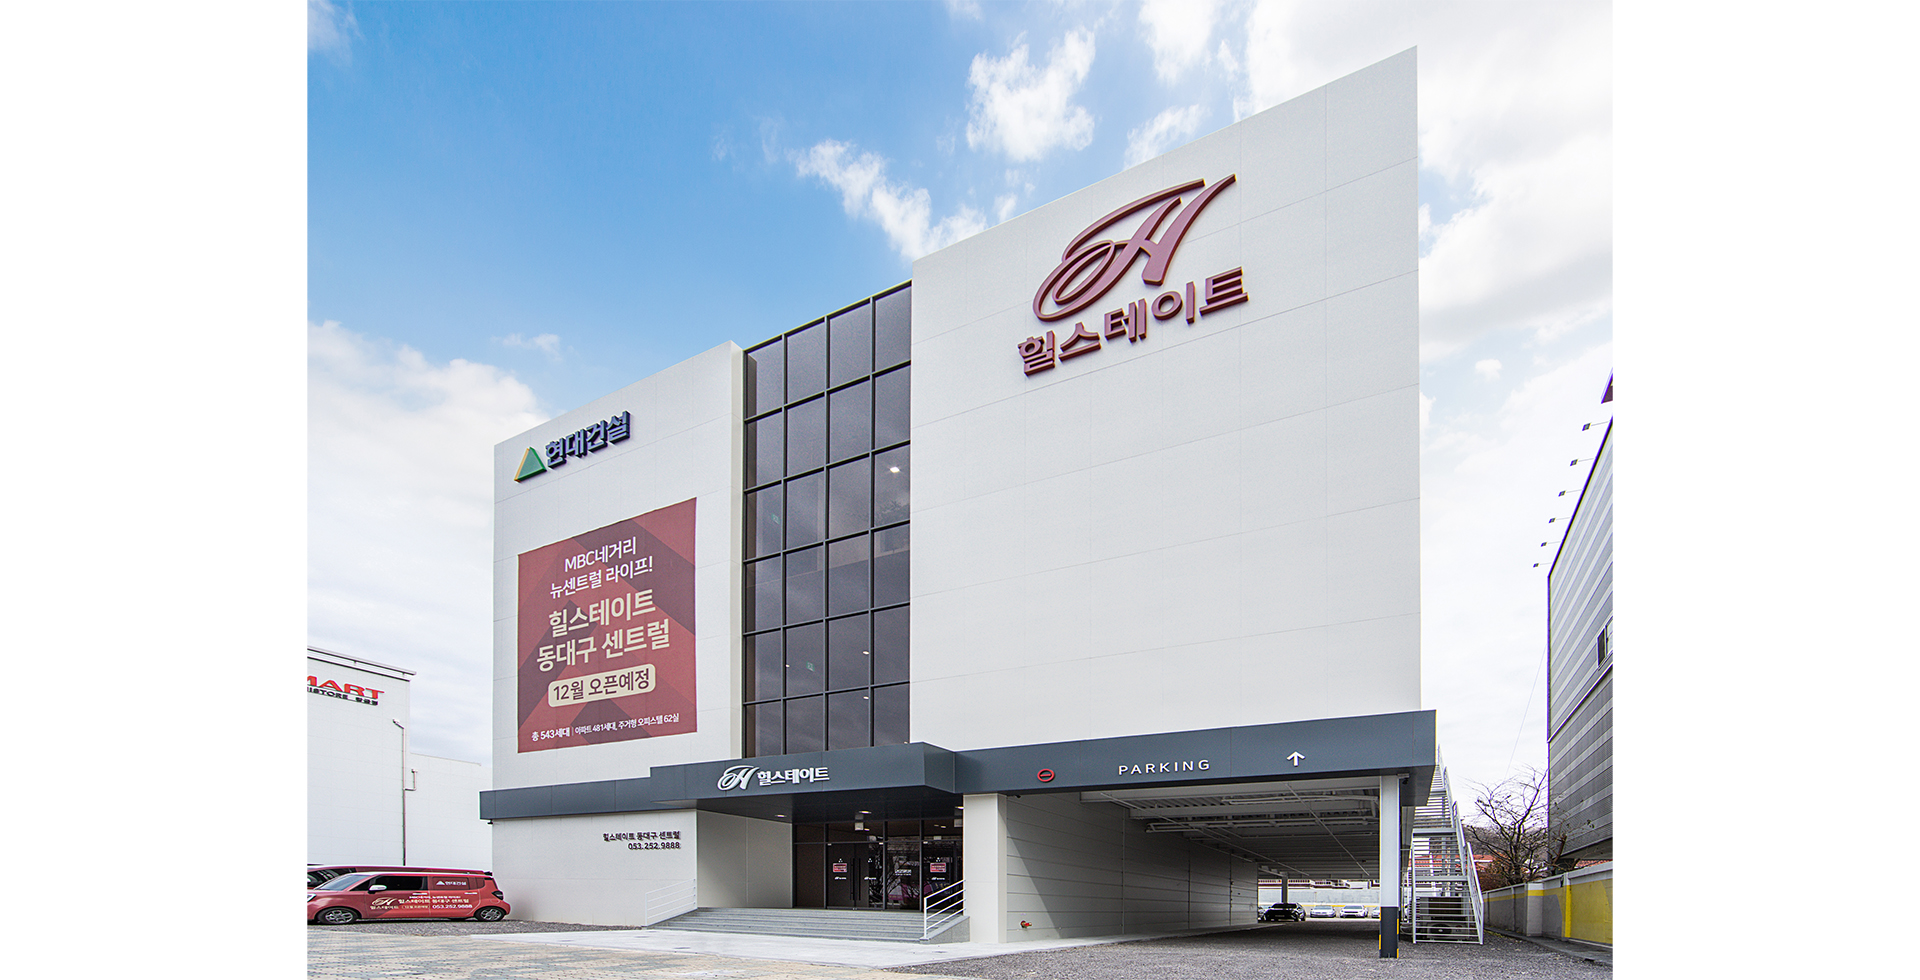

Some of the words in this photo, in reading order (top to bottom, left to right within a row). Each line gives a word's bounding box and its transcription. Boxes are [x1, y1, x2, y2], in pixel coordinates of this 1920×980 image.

[1018, 266, 1250, 377] 힐스테이트
[545, 410, 631, 469] 현대건설
[564, 536, 637, 573] MBC네거리
[550, 569, 602, 600] 뉴센트럴
[605, 555, 653, 584] 라이프!
[549, 588, 657, 638] 힐스테이트
[536, 636, 598, 673] 동대구
[601, 618, 671, 660] 센트럴
[553, 680, 585, 701] 12월
[588, 668, 650, 697] 오픈예정
[531, 731, 540, 742] 총
[540, 727, 571, 740] 543세대
[574, 724, 592, 735] 아파트
[618, 718, 637, 730] 주거형
[637, 714, 663, 727] 오피스텔
[663, 712, 680, 723] 62실
[757, 767, 831, 786] 힐스테이트
[1118, 759, 1212, 776] PARKING
[602, 832, 636, 842] 힐스테이트
[636, 831, 658, 841] 동대구
[628, 841, 681, 850] 053.252.9888
